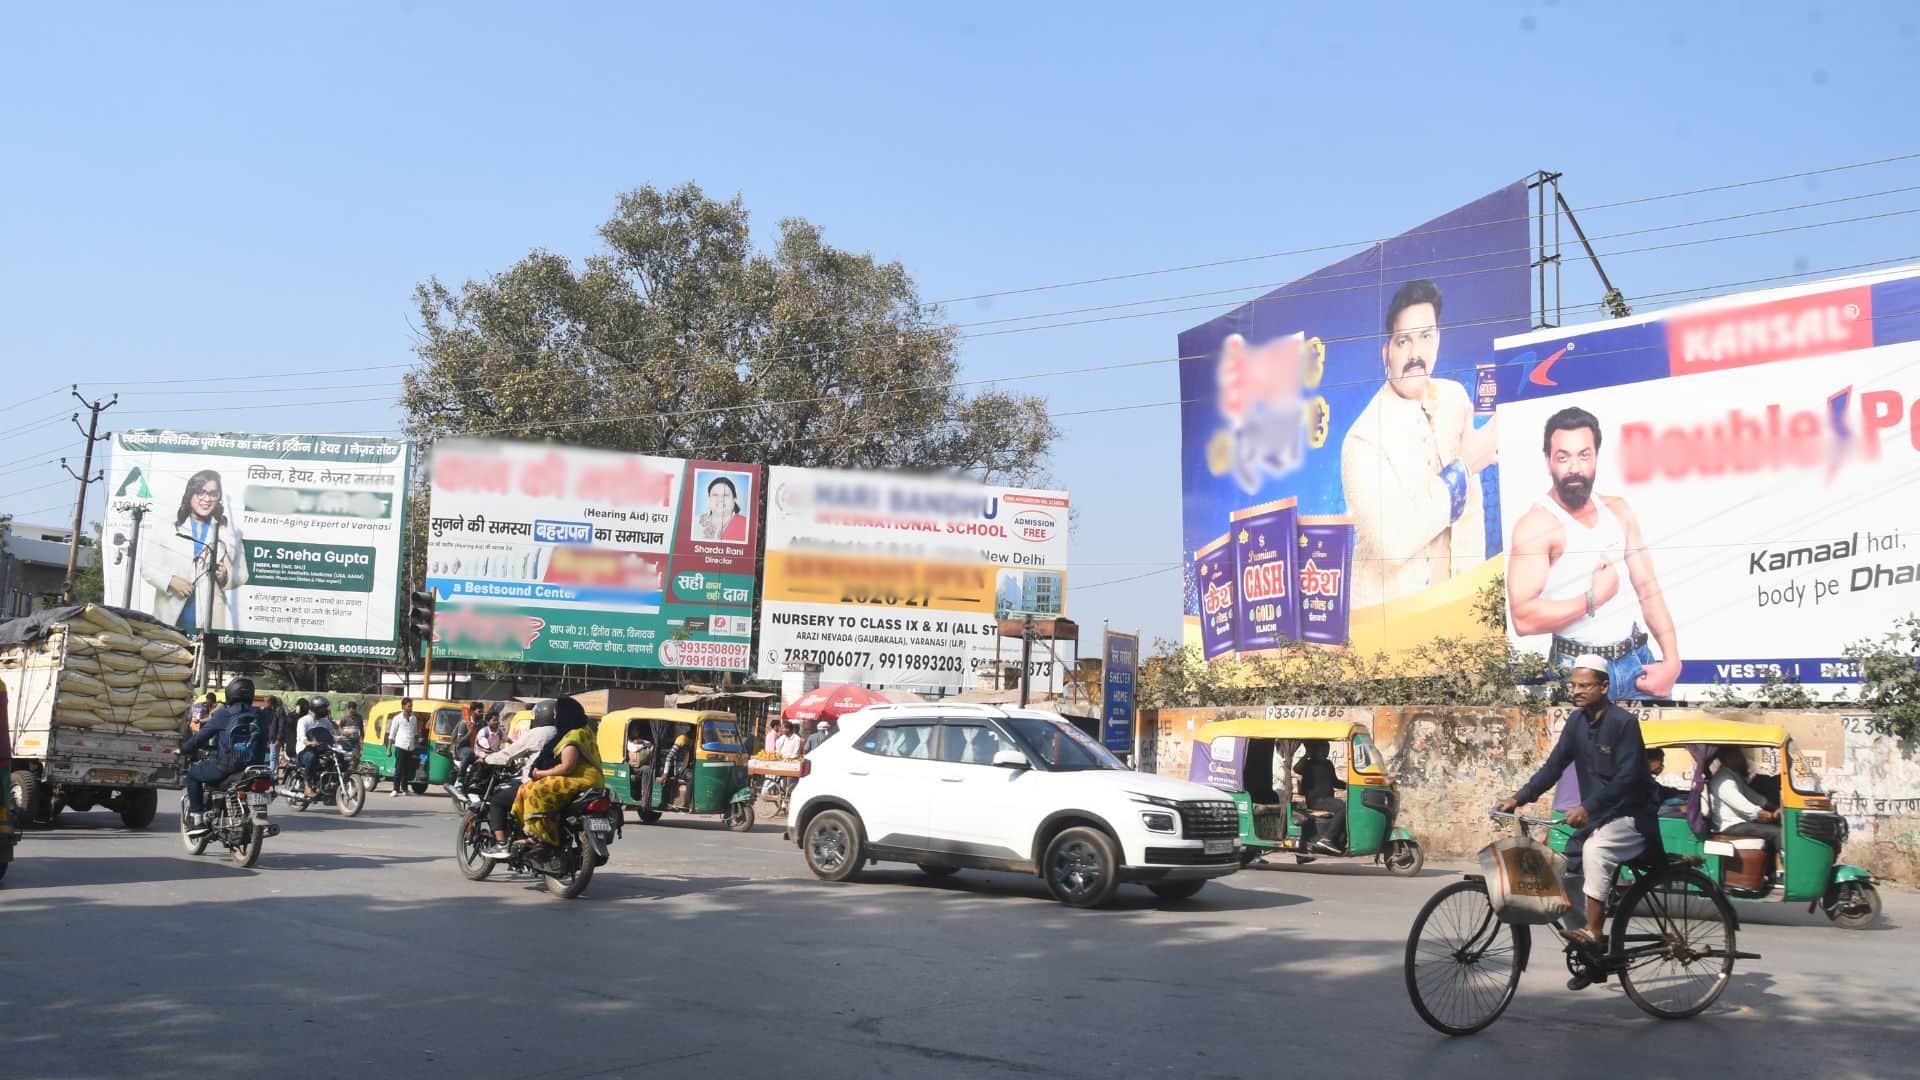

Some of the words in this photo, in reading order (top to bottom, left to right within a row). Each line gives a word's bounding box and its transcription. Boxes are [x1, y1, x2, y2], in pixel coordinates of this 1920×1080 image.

[1680, 305, 1849, 363] KANSAL
[320, 442, 341, 455] हेयर
[247, 464, 285, 483] स्किन,
[288, 467, 317, 483] हेयर,
[243, 515, 260, 524] The
[260, 517, 309, 529] Anti-Aging
[311, 520, 339, 530] Expert
[341, 521, 349, 529] of
[351, 522, 392, 531] Varanasi
[584, 507, 627, 523] (Hearing
[629, 511, 649, 522] Aid)
[1014, 517, 1055, 528] ADMISSION
[431, 514, 464, 537] सुनने
[467, 514, 485, 534] की
[488, 520, 532, 536] समस्या
[536, 520, 590, 541] बहरापन
[594, 528, 611, 542] का
[615, 528, 664, 545] समाधान
[814, 510, 942, 533] INTERNATIONAL
[945, 521, 1008, 538] SCHOOL
[1023, 527, 1047, 539] FREE
[253, 546, 273, 559] Dr.
[276, 547, 321, 562] Sneha
[324, 551, 369, 567] Gupta
[694, 545, 724, 554] Sharda
[725, 546, 744, 556] Rani
[981, 549, 1010, 563] New
[1012, 551, 1045, 566] Delhi
[1749, 532, 1858, 575] Kamaal
[1867, 528, 1907, 553] hai,
[704, 556, 733, 565] Director
[677, 572, 705, 590] सही
[1244, 562, 1285, 601] CASH
[1300, 558, 1341, 596] कैश
[453, 583, 461, 592] a
[465, 581, 532, 597] Bestsound
[535, 585, 577, 599] Center
[1757, 579, 1806, 609] body
[1814, 578, 1841, 605] pe
[1849, 563, 1920, 592] Dha
[722, 588, 749, 603] दाम
[1255, 604, 1275, 622] GOLD
[771, 612, 835, 627] NURSERY
[839, 616, 857, 628] TO
[860, 617, 902, 631] CLASS
[905, 620, 918, 632] IX
[922, 620, 932, 632] &
[935, 621, 948, 633] XI
[952, 621, 979, 636] (ALL
[796, 631, 820, 641] ARAZI
[821, 632, 853, 642] NEVADA
[910, 636, 947, 647] VARANASI
[679, 642, 749, 655] 9935508097
[678, 654, 747, 668] 7991818161
[784, 648, 875, 670] 7887006077,
[879, 652, 966, 673] 9919893203,
[1109, 671, 1131, 685] SHELTER
[1716, 663, 1783, 679] VESTS
[1113, 690, 1128, 703] HOME
